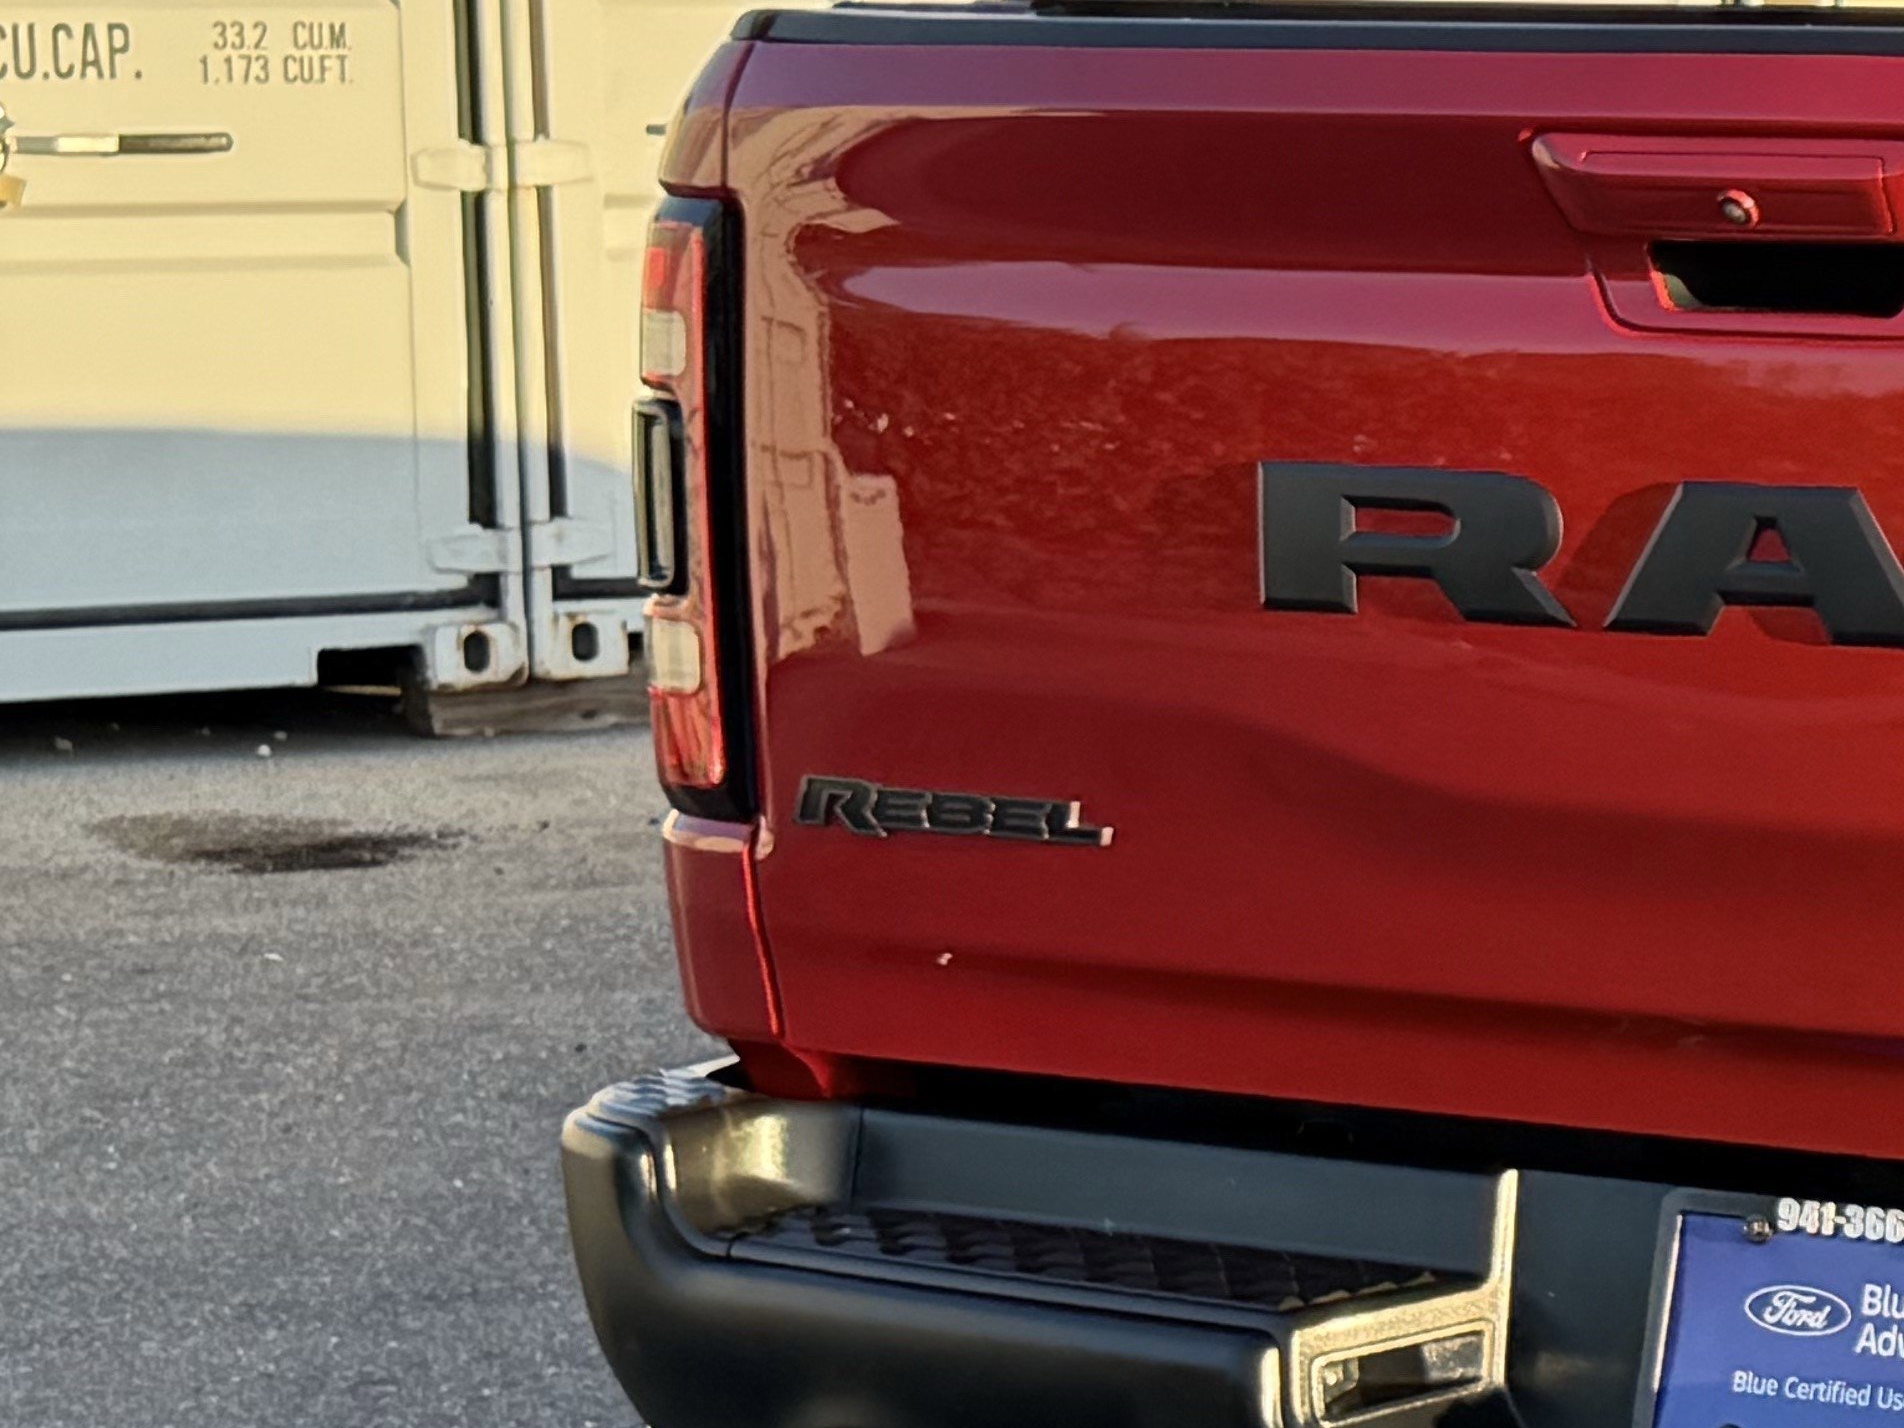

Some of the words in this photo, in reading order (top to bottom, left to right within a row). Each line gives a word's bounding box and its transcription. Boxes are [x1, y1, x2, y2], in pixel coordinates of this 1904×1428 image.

[212, 20, 268, 50] 33.2
[199, 54, 269, 84] 1.173
[795, 774, 1114, 847] REBEL
[1762, 1292, 1830, 1330] Ford
[1733, 1370, 1778, 1397] Blue
[1784, 1375, 1871, 1408] Certified
